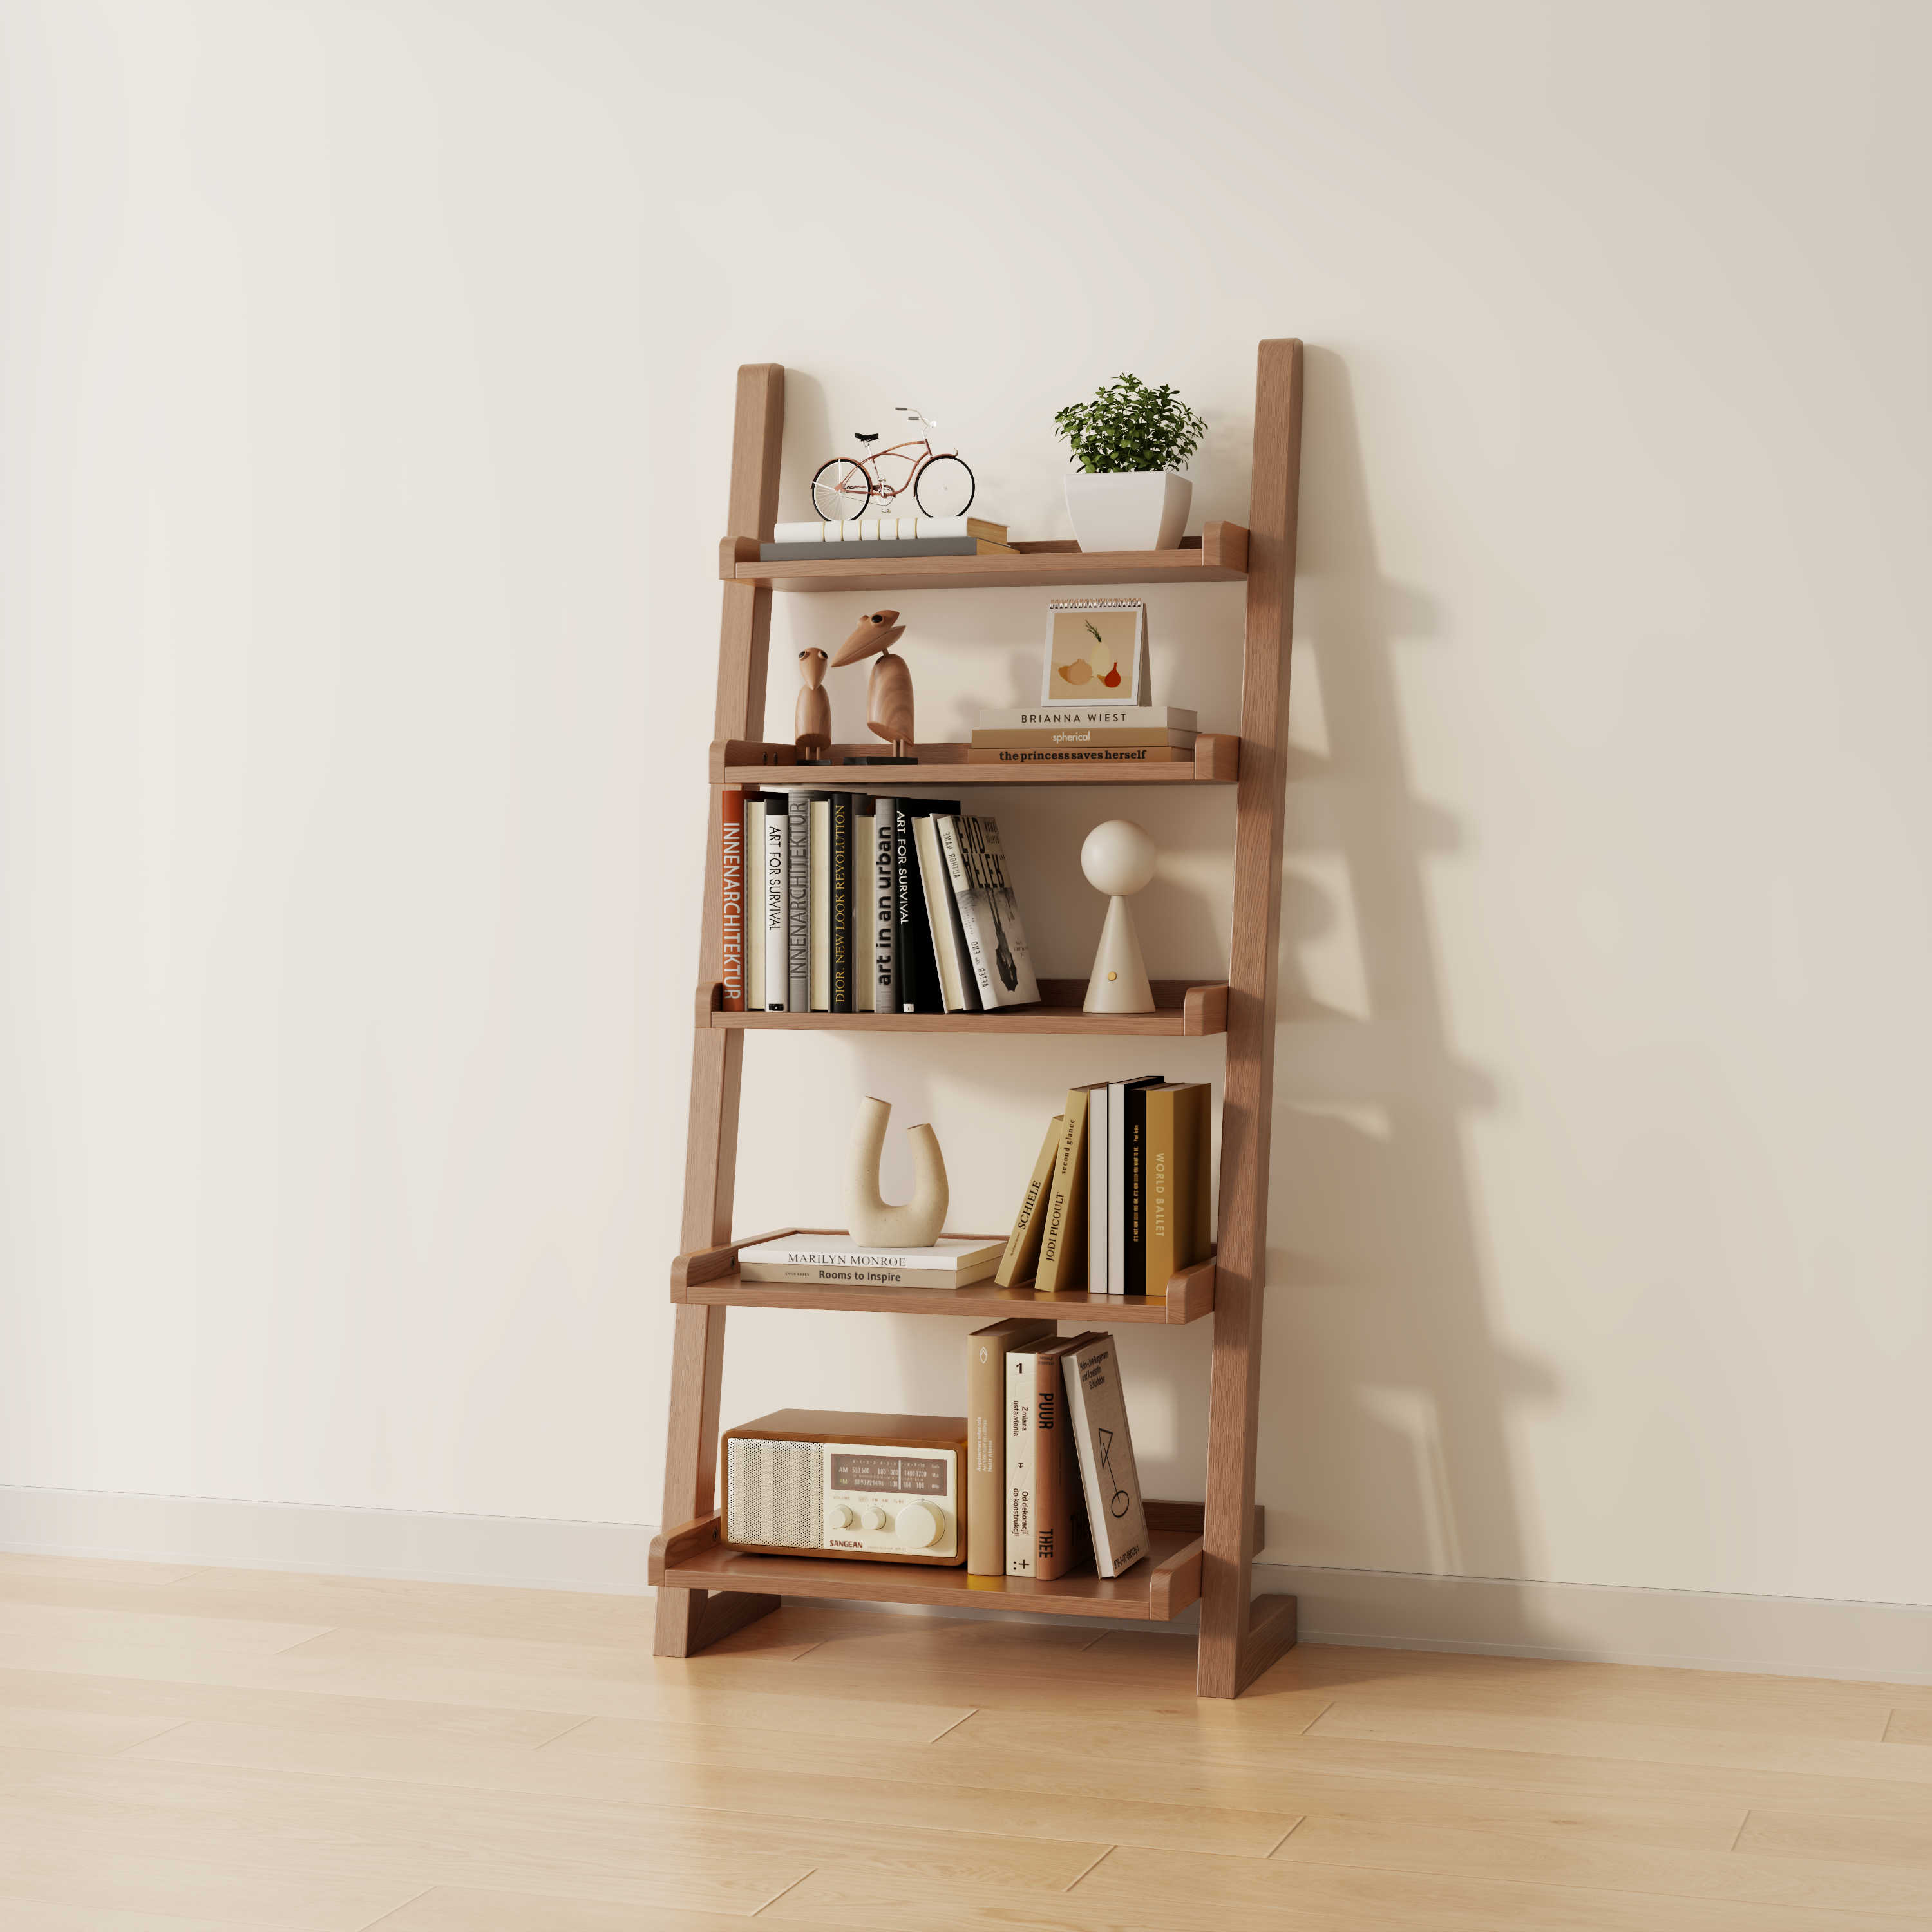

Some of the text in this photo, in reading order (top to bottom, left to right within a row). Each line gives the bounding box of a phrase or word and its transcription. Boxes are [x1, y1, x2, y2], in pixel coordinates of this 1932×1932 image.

[1021, 714, 1126, 723] BRIANNA WIEST
[1052, 730, 1090, 744] spherical
[999, 750, 1147, 762] the princess saves herself
[769, 826, 781, 931] ART FOR SURVIVAL
[896, 810, 909, 925] ART FOR SURVIVAL
[790, 802, 807, 979] INNENARCHITEKTUR
[835, 805, 845, 1003] DIOR. NEW LOOK REVOLUTION
[876, 826, 891, 986] art in an urban
[723, 822, 741, 999] INNENARCHITEKTUR
[1061, 1119, 1075, 1175] second glance
[1018, 1180, 1041, 1230] SCHIELE
[1155, 1153, 1165, 1237] WORLD BALLET
[1045, 1192, 1065, 1262] JODI PICOULT
[788, 1253, 906, 1267] MARILYN MONROE
[819, 1270, 851, 1280] Rooms
[867, 1272, 901, 1283] Inspire
[1016, 1363, 1023, 1374] 1
[1039, 1393, 1054, 1430] PUUR
[1013, 1488, 1019, 1497] do
[1022, 1491, 1028, 1501] Od
[829, 1540, 863, 1548] SANGEAN
[1039, 1528, 1054, 1558] THEE
